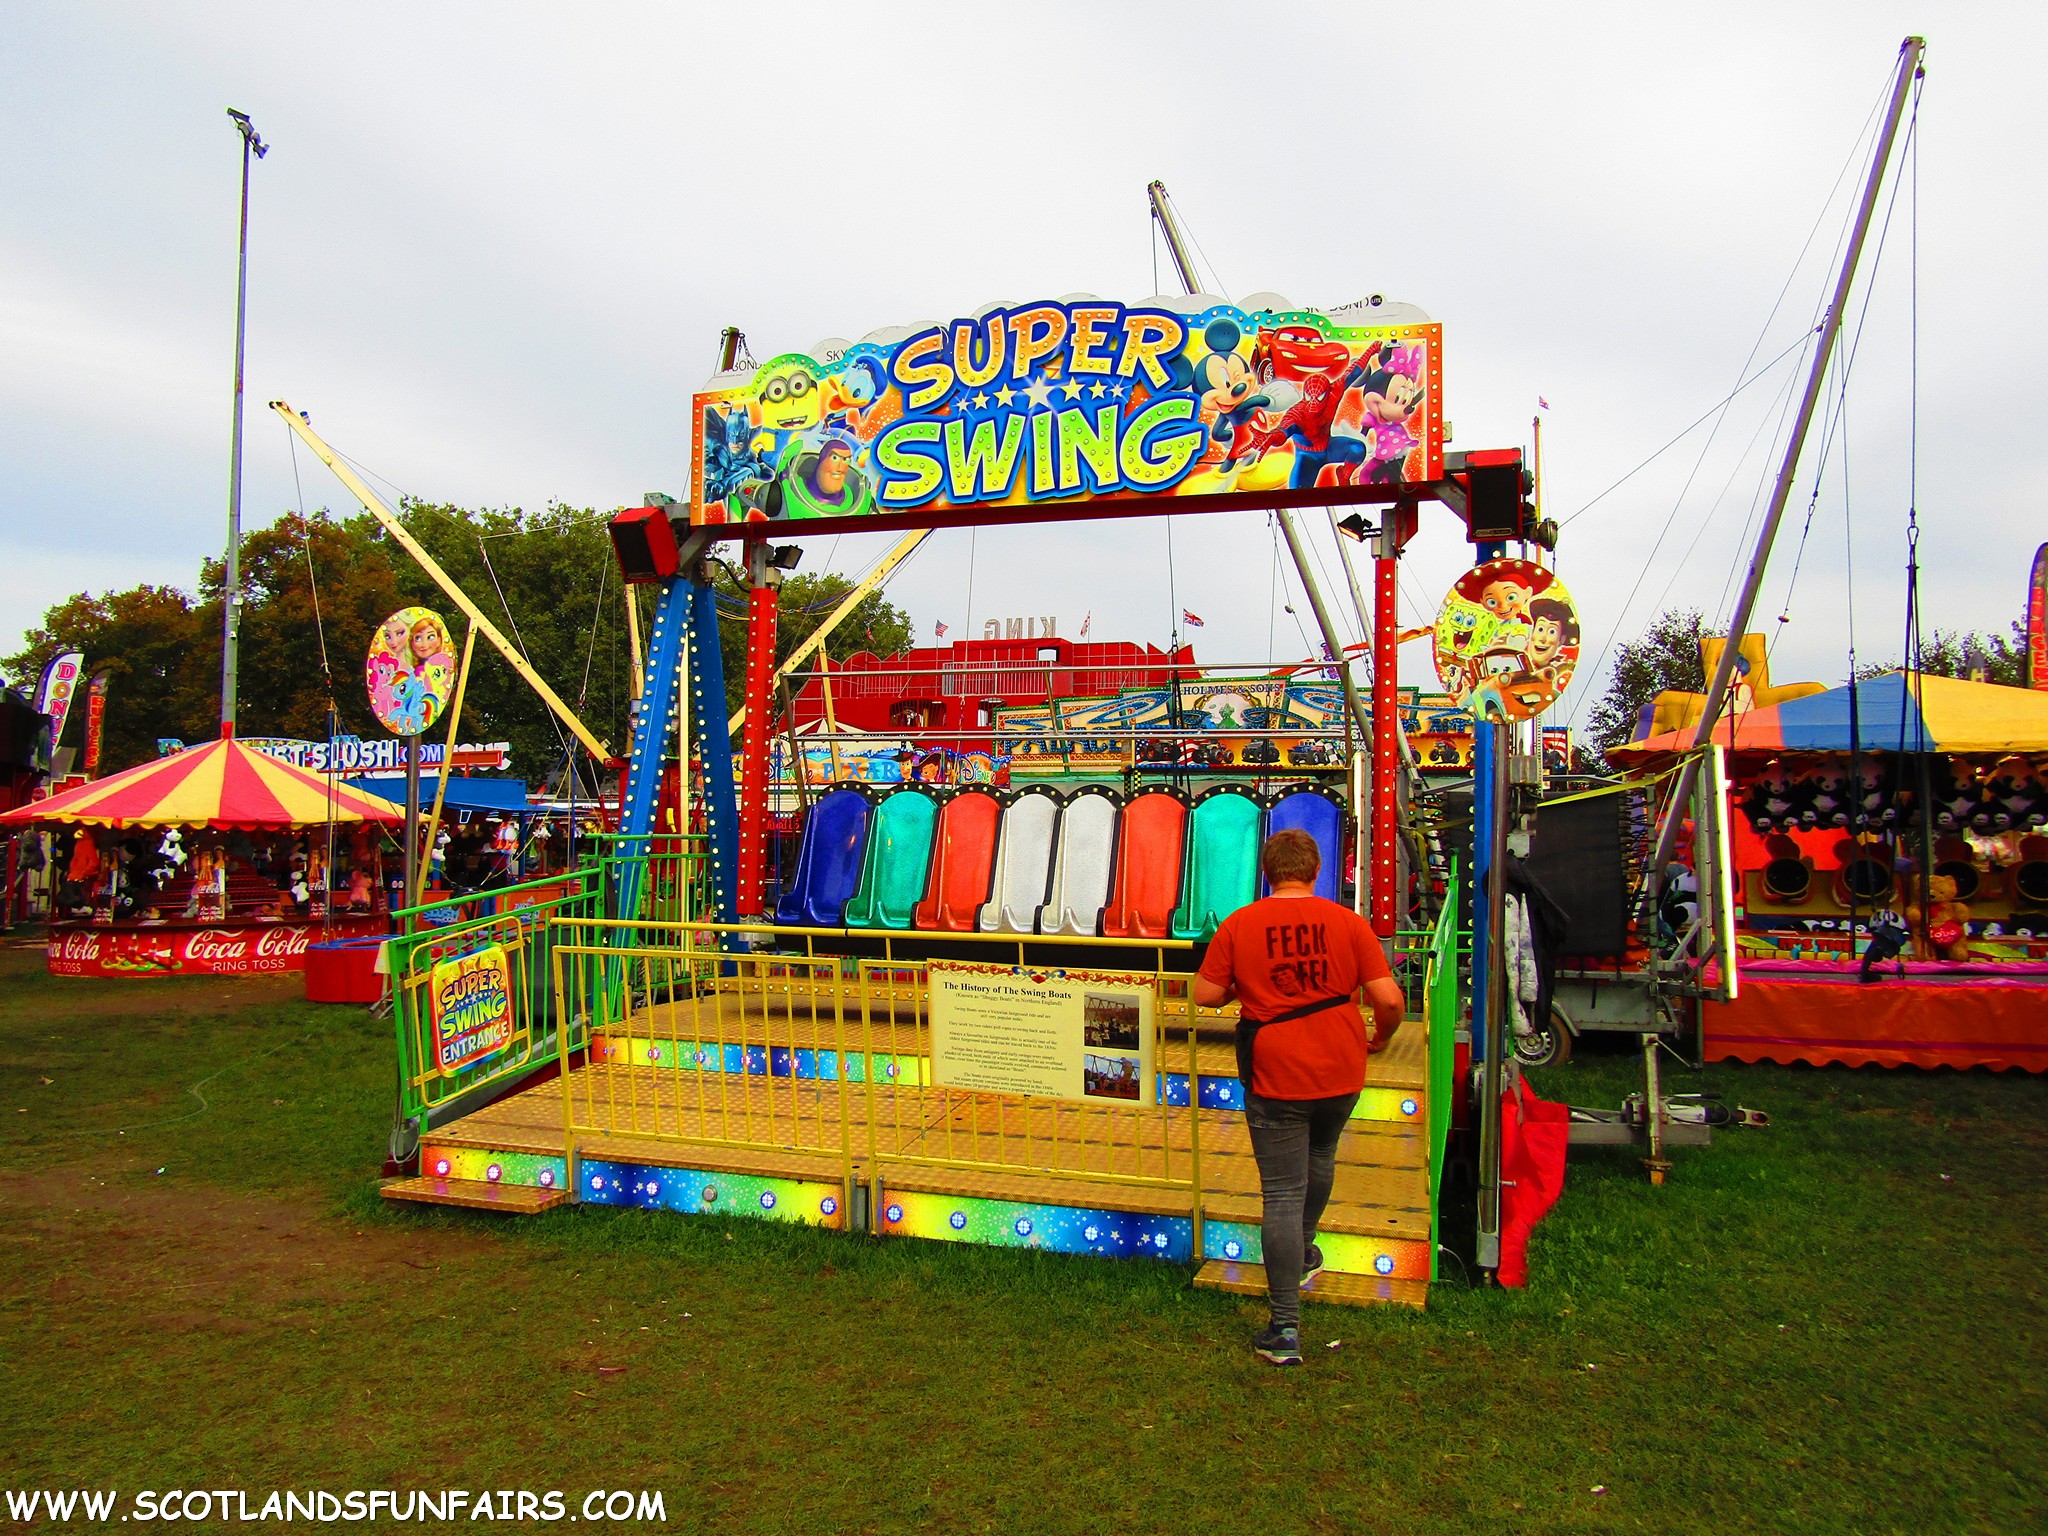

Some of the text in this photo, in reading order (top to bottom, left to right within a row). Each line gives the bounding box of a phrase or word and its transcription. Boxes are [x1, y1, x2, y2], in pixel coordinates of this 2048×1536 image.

[826, 349, 848, 362] SKY
[891, 305, 1184, 411] SUPER
[875, 397, 1203, 502] SWING
[1183, 683, 1280, 695] HOLMES & SONS
[66, 930, 100, 960] Cola
[185, 925, 311, 959] Coca Cola
[1266, 923, 1327, 959] FECK
[212, 958, 285, 972] RING TOSS
[442, 969, 501, 1011] SUPER
[943, 981, 1072, 1001] The History of The Swing Boats
[440, 991, 507, 1040] SWING
[442, 1020, 510, 1065] ENTRANCE
